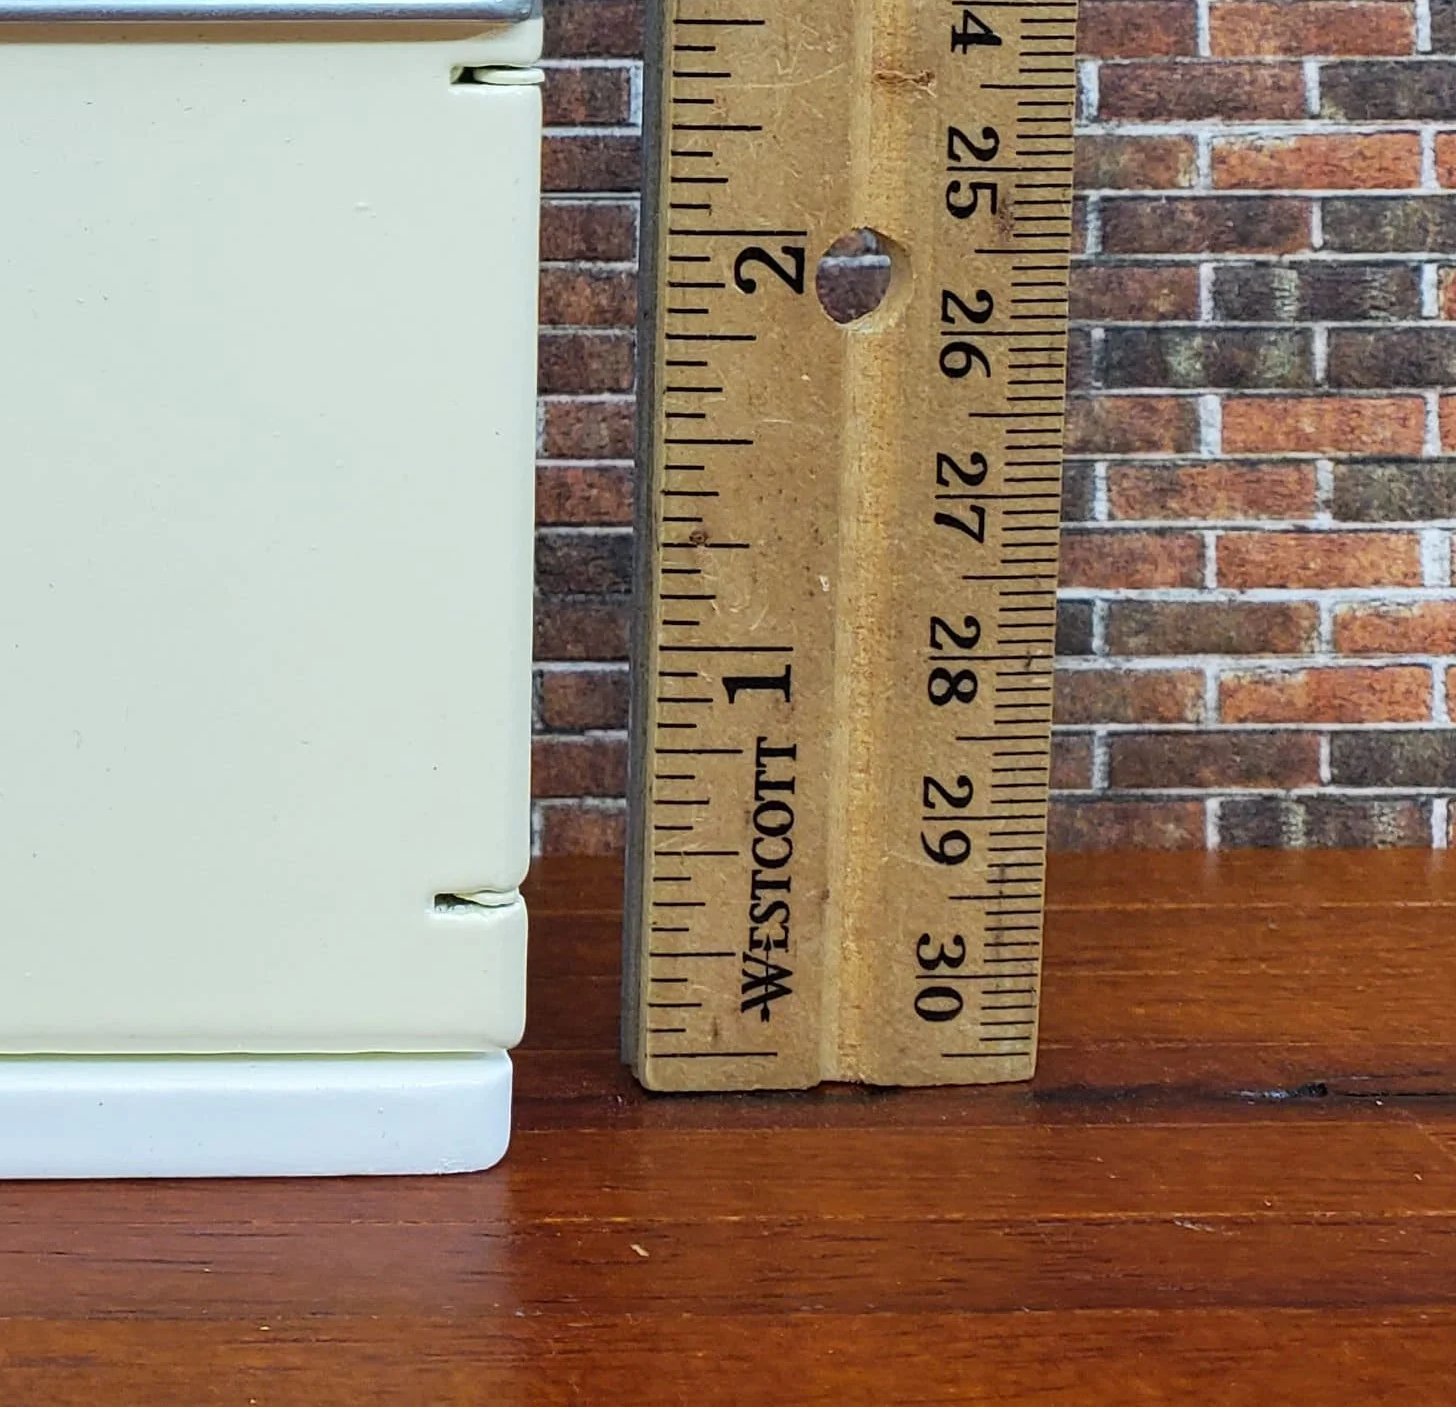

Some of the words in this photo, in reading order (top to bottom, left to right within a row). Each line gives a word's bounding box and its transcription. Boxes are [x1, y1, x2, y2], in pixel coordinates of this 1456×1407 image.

[946, 126, 999, 219] 25
[734, 245, 805, 294] 2
[939, 289, 994, 378] 26
[935, 452, 988, 543] 27
[722, 664, 791, 704] 1
[928, 615, 981, 706] 28
[921, 775, 973, 865] 29
[741, 736, 797, 1014] WESTCOTT
[914, 934, 966, 1022] 30
